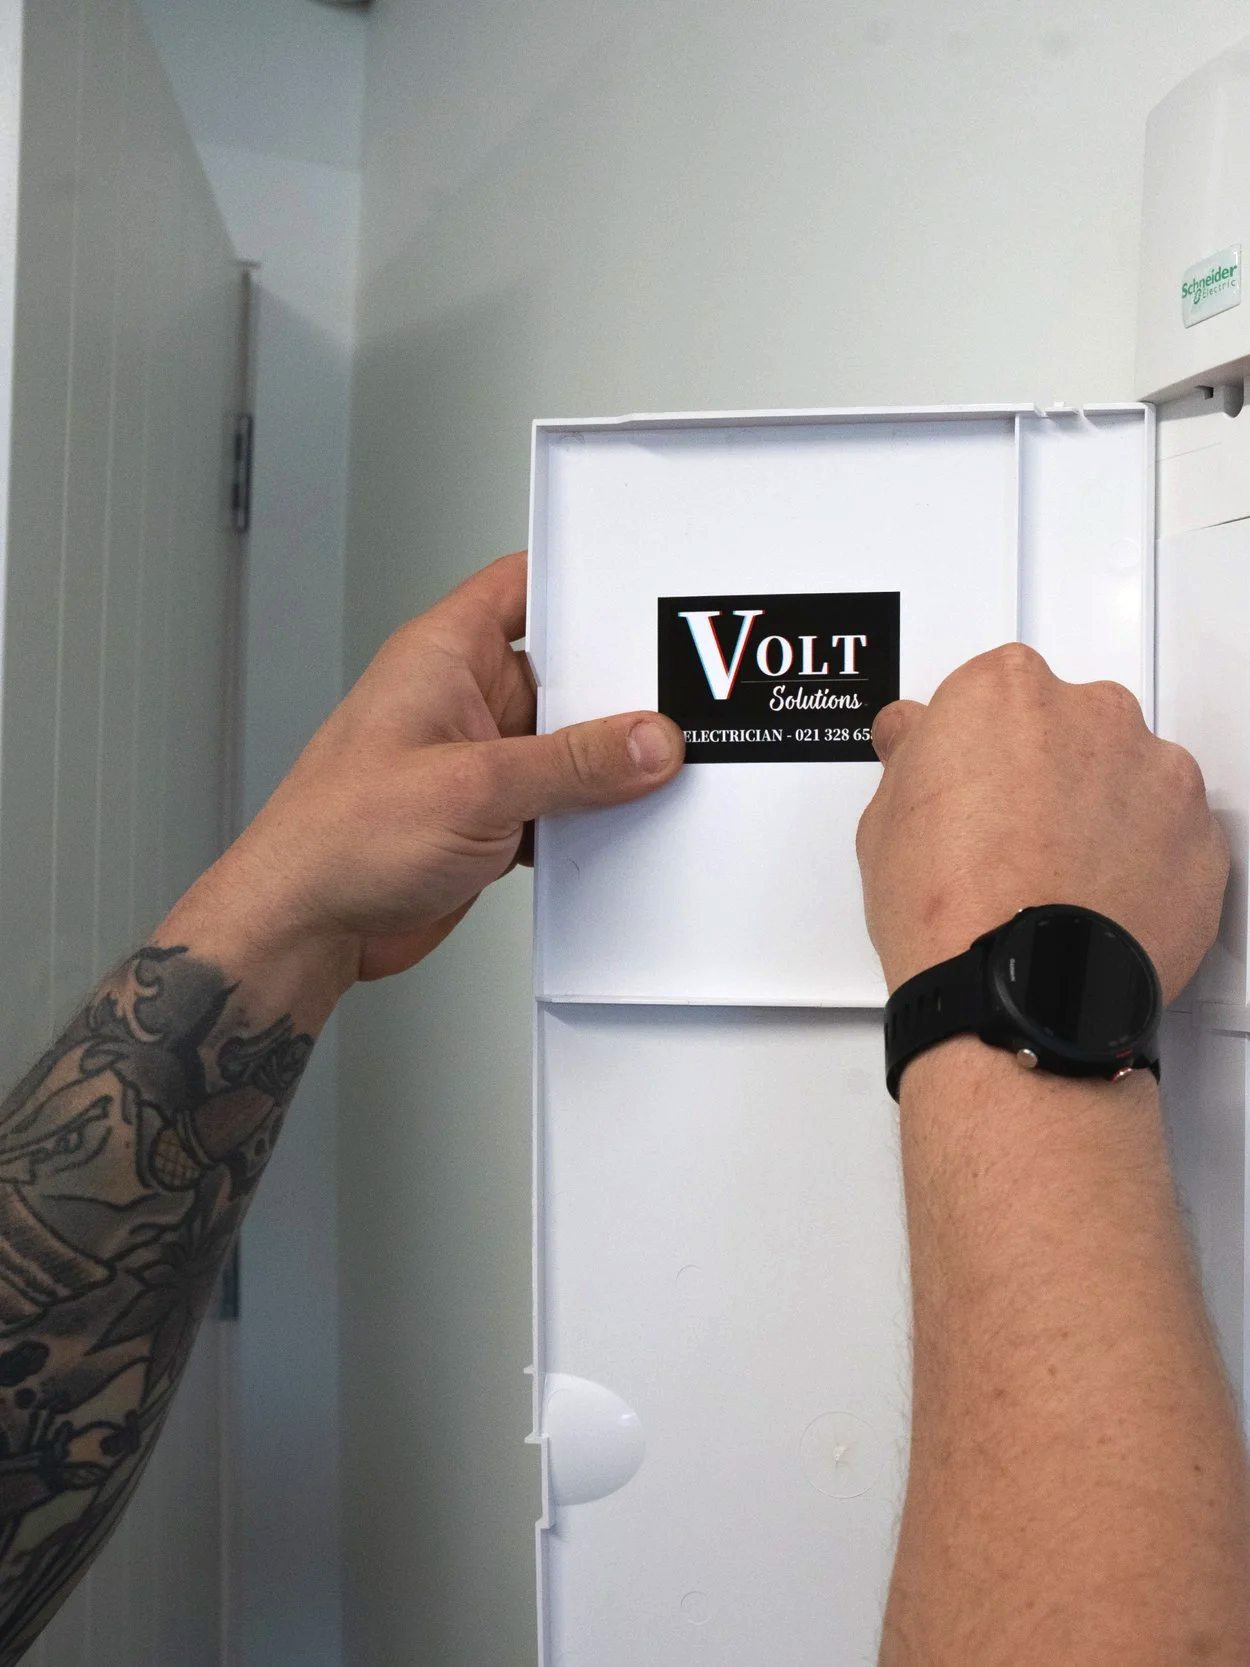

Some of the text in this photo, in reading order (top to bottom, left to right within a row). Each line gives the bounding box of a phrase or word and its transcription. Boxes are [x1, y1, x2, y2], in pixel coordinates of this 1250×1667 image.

[1182, 264, 1238, 304] Schneider
[1201, 280, 1236, 299] Electric
[677, 609, 868, 700] VOLT
[769, 684, 863, 712] Solutions
[682, 728, 783, 743] ELECTRICIAN
[795, 728, 820, 742] 021
[824, 728, 850, 742] 328
[853, 728, 873, 741] 65
